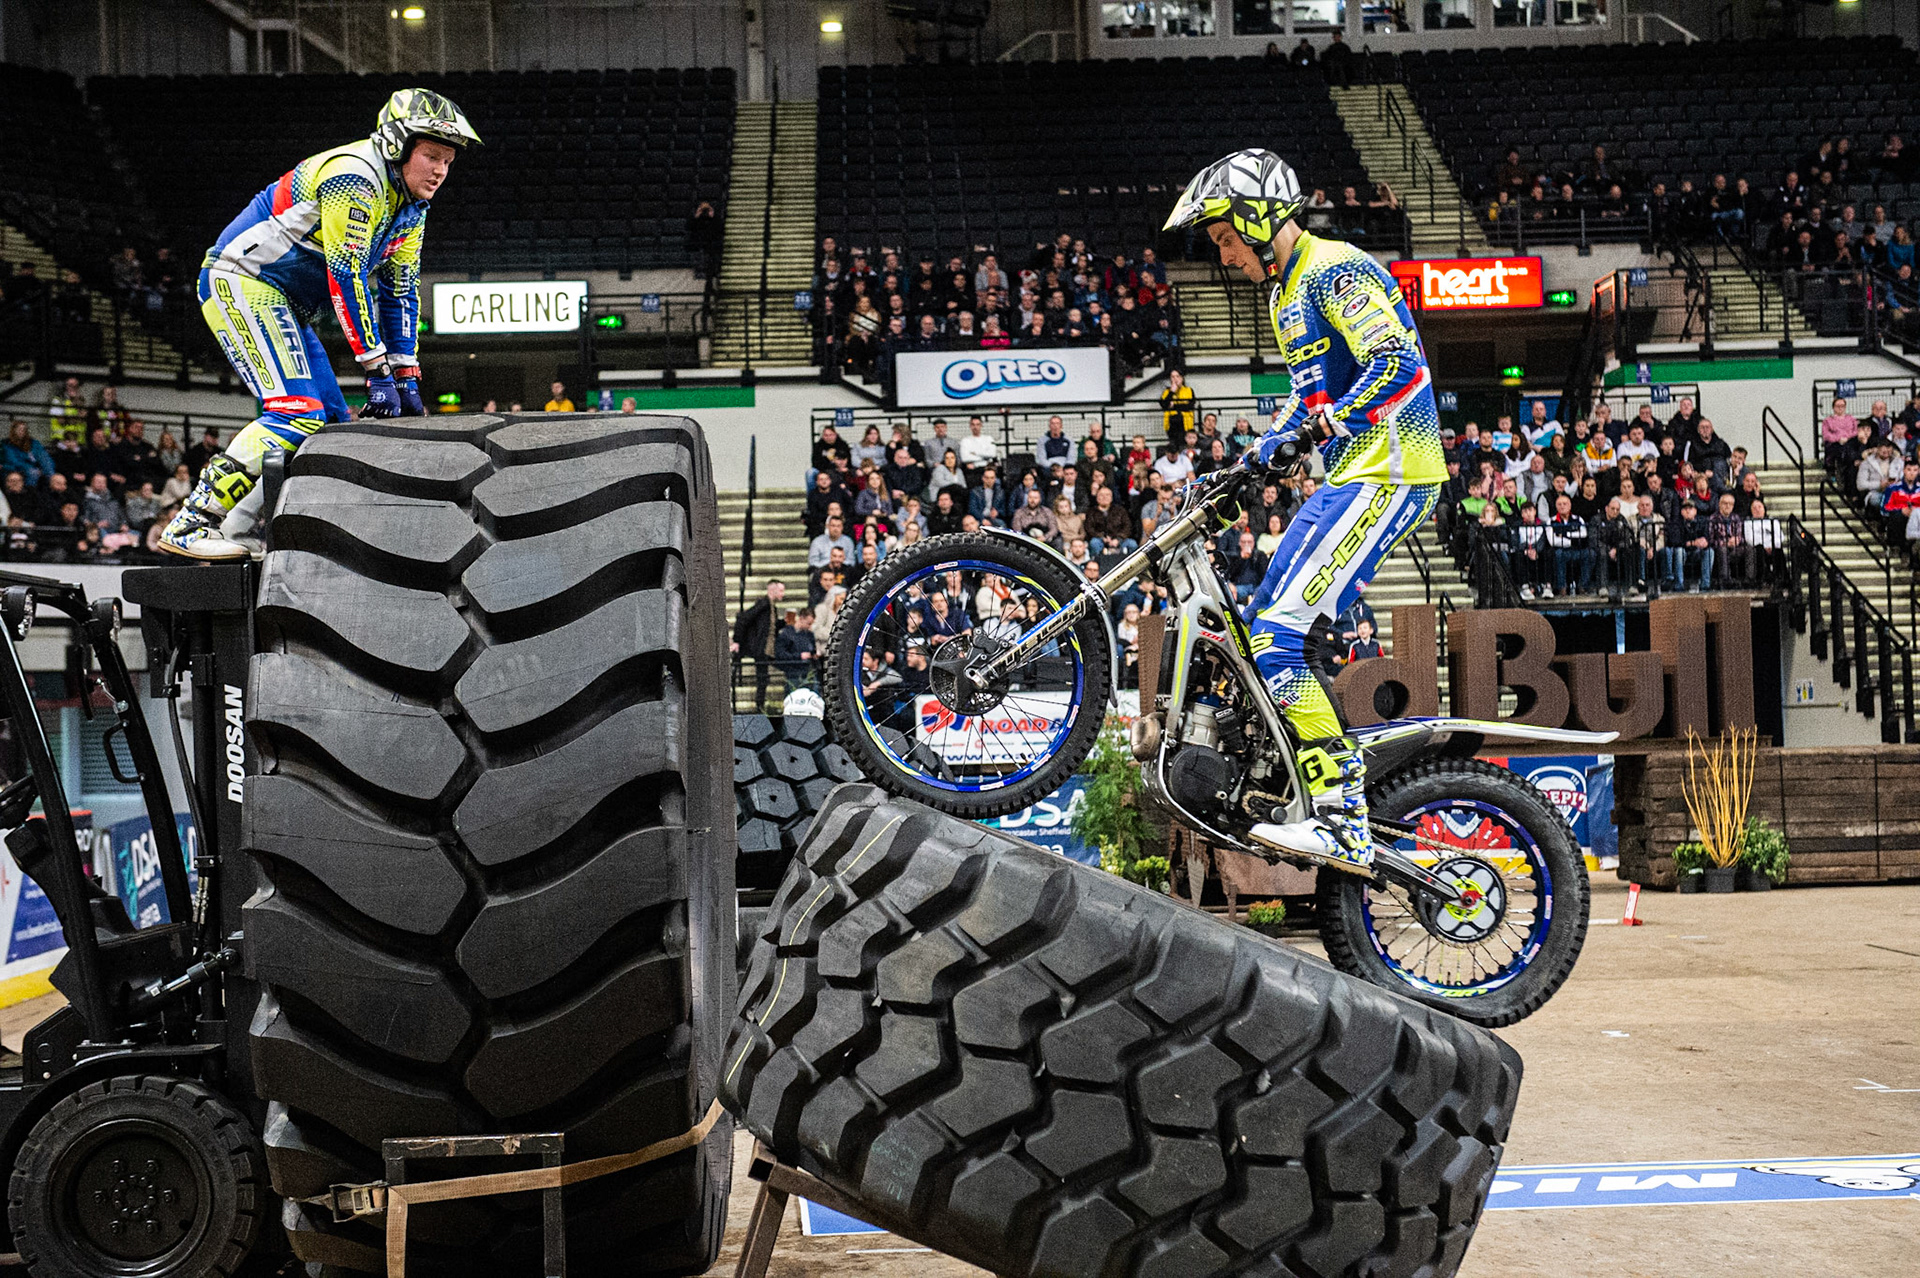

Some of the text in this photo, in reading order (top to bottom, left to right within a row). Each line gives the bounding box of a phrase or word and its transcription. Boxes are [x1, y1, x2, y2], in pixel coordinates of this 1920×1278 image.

[1422, 260, 1509, 297] heart
[452, 292, 570, 324] CARLING
[214, 277, 276, 391] SHERCO
[268, 305, 310, 377] MRS
[942, 359, 1066, 399] OREO
[1379, 501, 1418, 552] CLICE
[1224, 611, 1246, 657] SHERCO
[1447, 597, 1754, 741] Bull
[224, 684, 245, 804] DOOSAN
